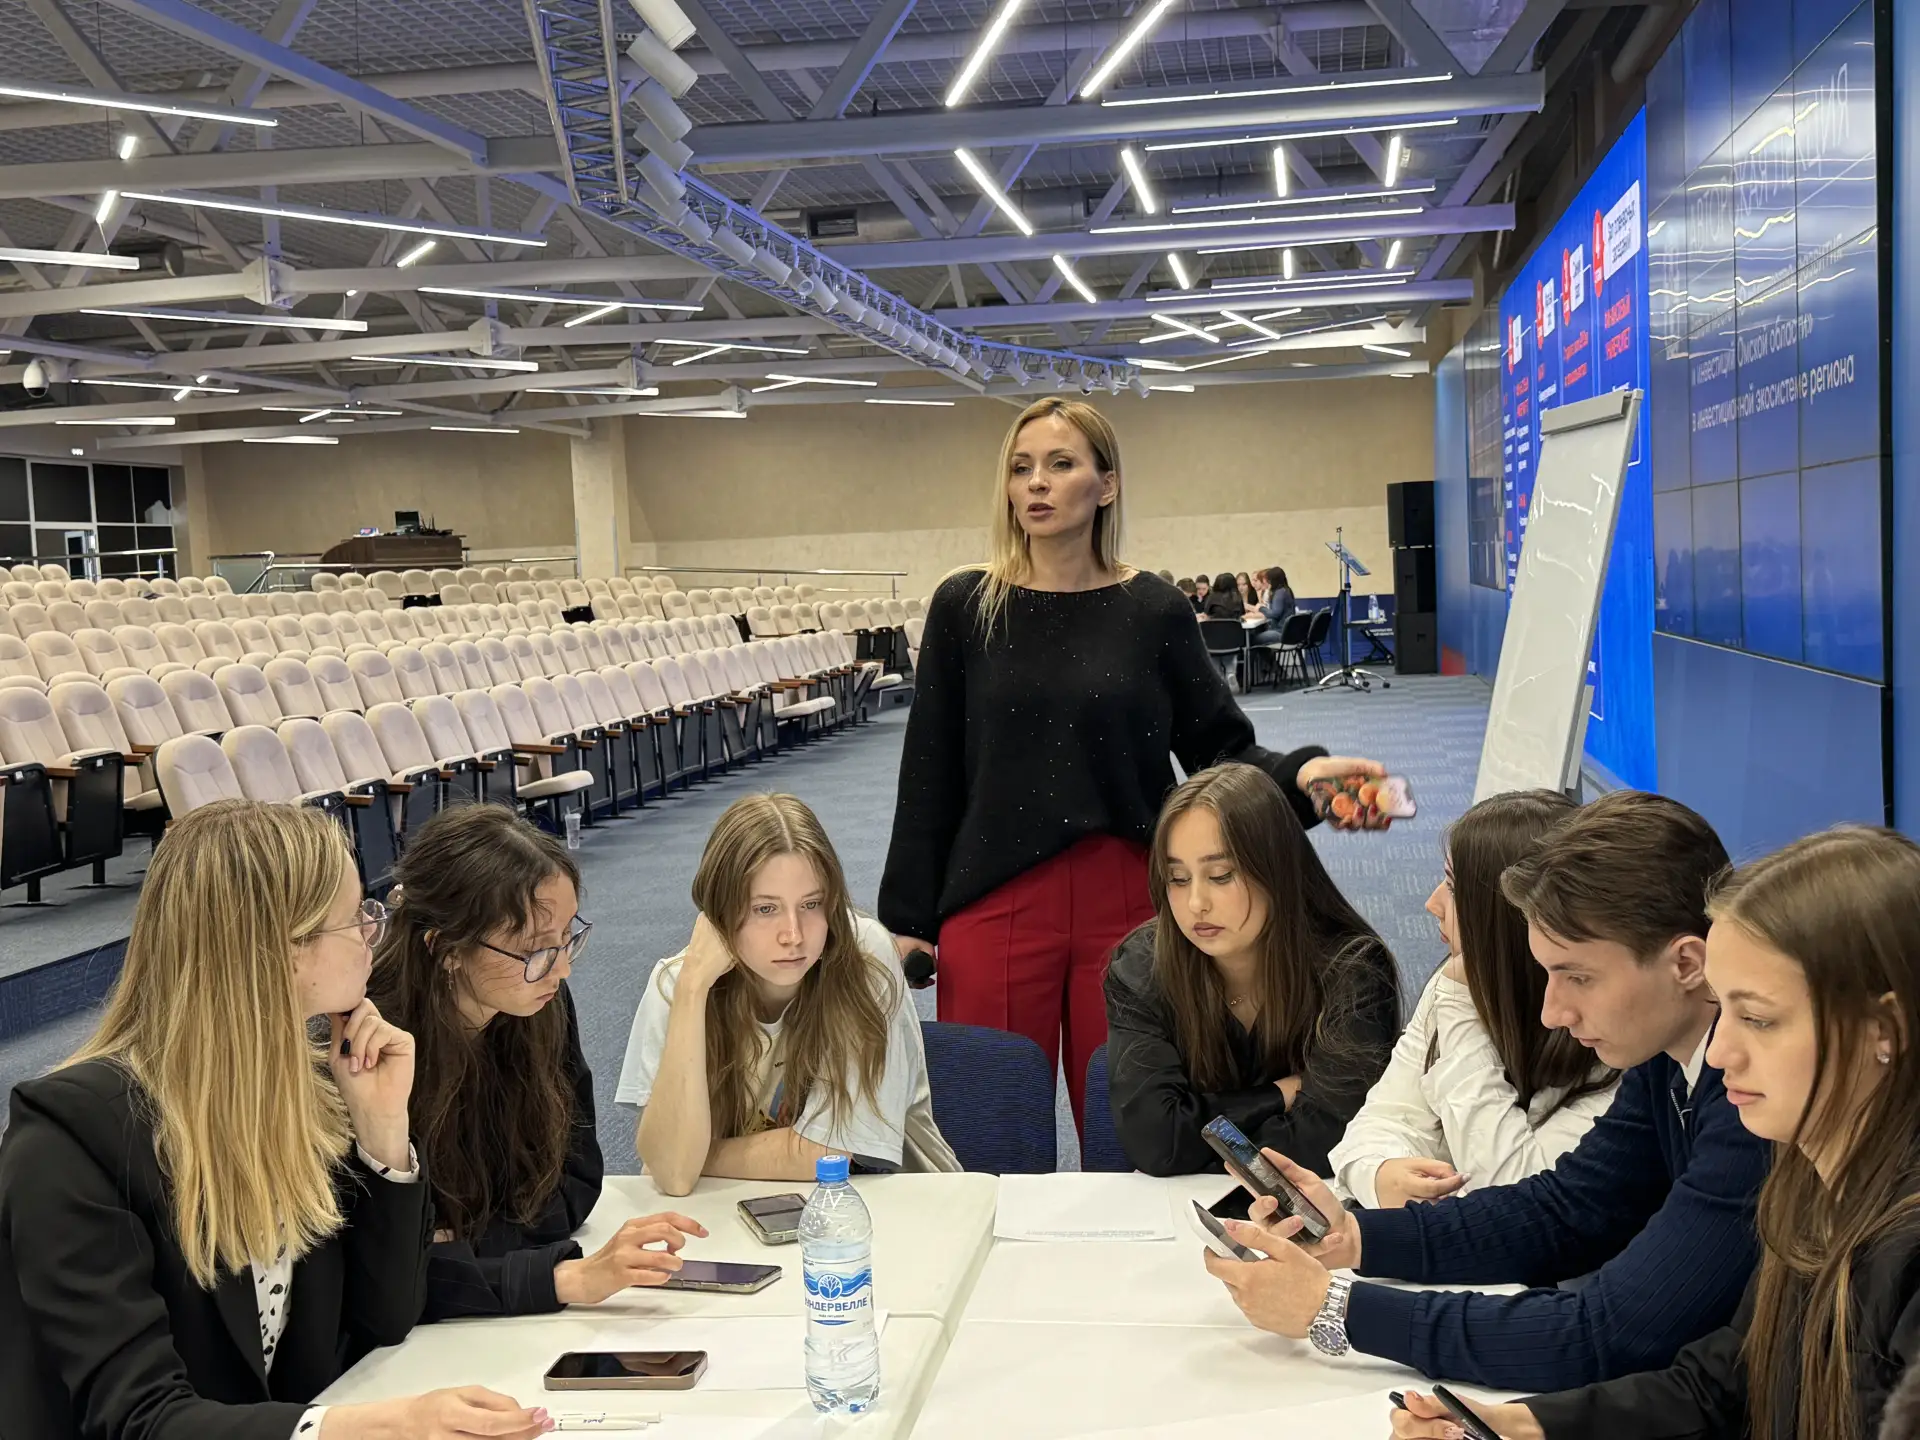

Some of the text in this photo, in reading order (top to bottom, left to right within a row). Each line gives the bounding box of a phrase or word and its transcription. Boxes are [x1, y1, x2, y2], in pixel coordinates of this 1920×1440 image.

[1697, 341, 1736, 384] инвестиций
[1737, 325, 1768, 368] Омской
[1697, 383, 1755, 430] инвестиционной
[1755, 371, 1807, 413] экосистеме
[1809, 354, 1856, 406] региона
